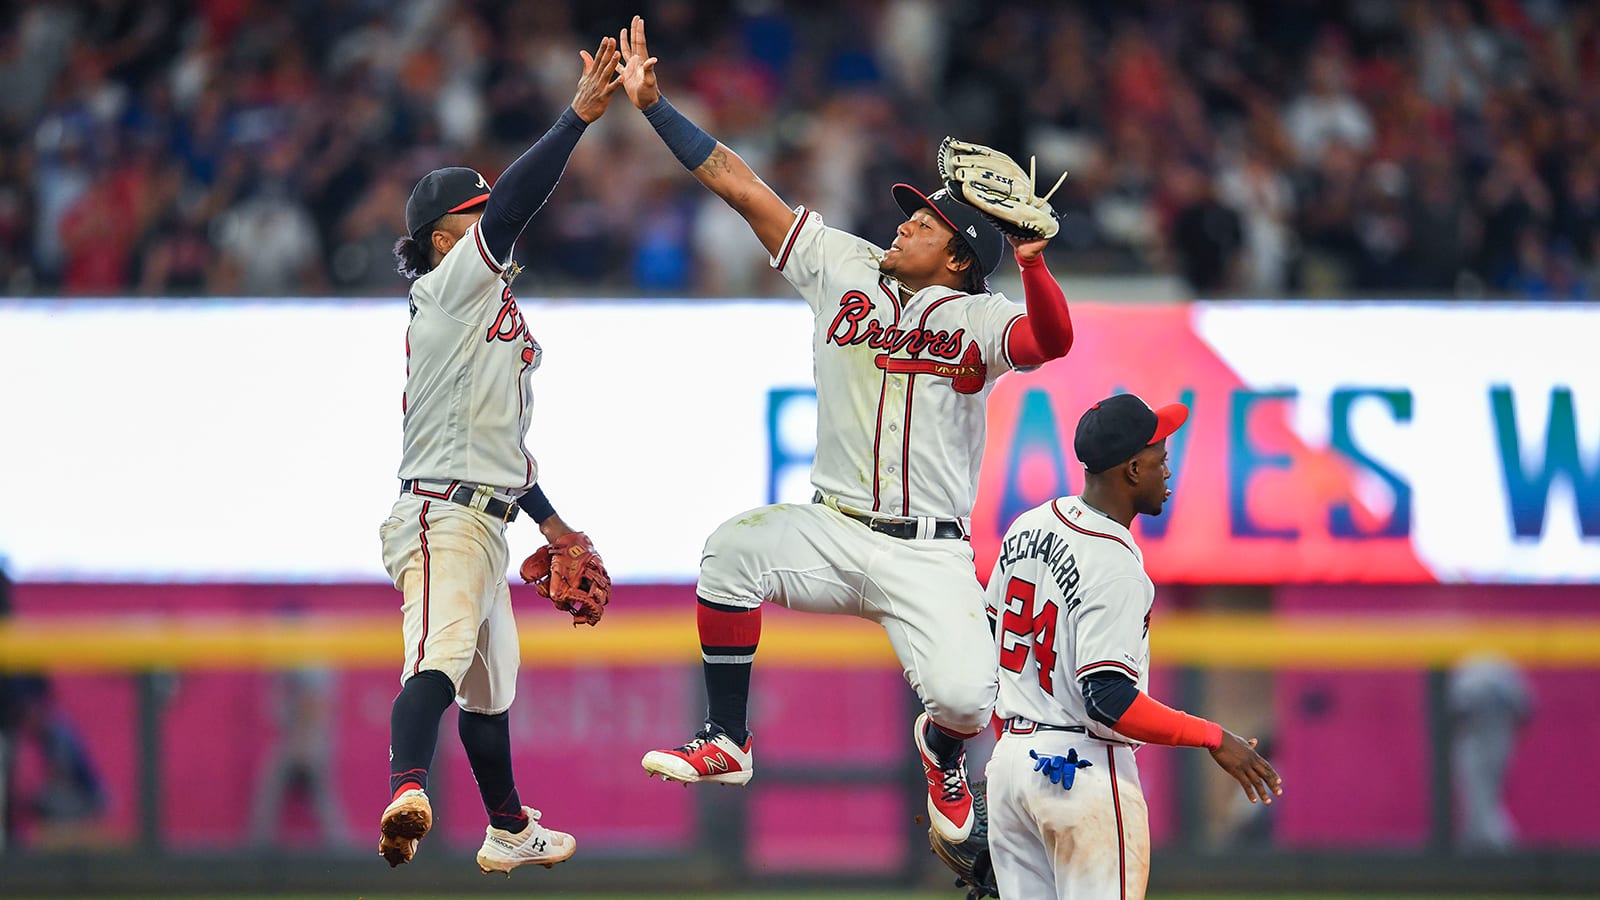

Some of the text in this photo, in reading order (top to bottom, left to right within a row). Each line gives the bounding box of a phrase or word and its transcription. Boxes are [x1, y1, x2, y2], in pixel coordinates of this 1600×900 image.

[994, 175, 1015, 185] SSK
[826, 289, 966, 359] Braves
[767, 387, 1413, 539] AVES
[998, 575, 1060, 697] 24
